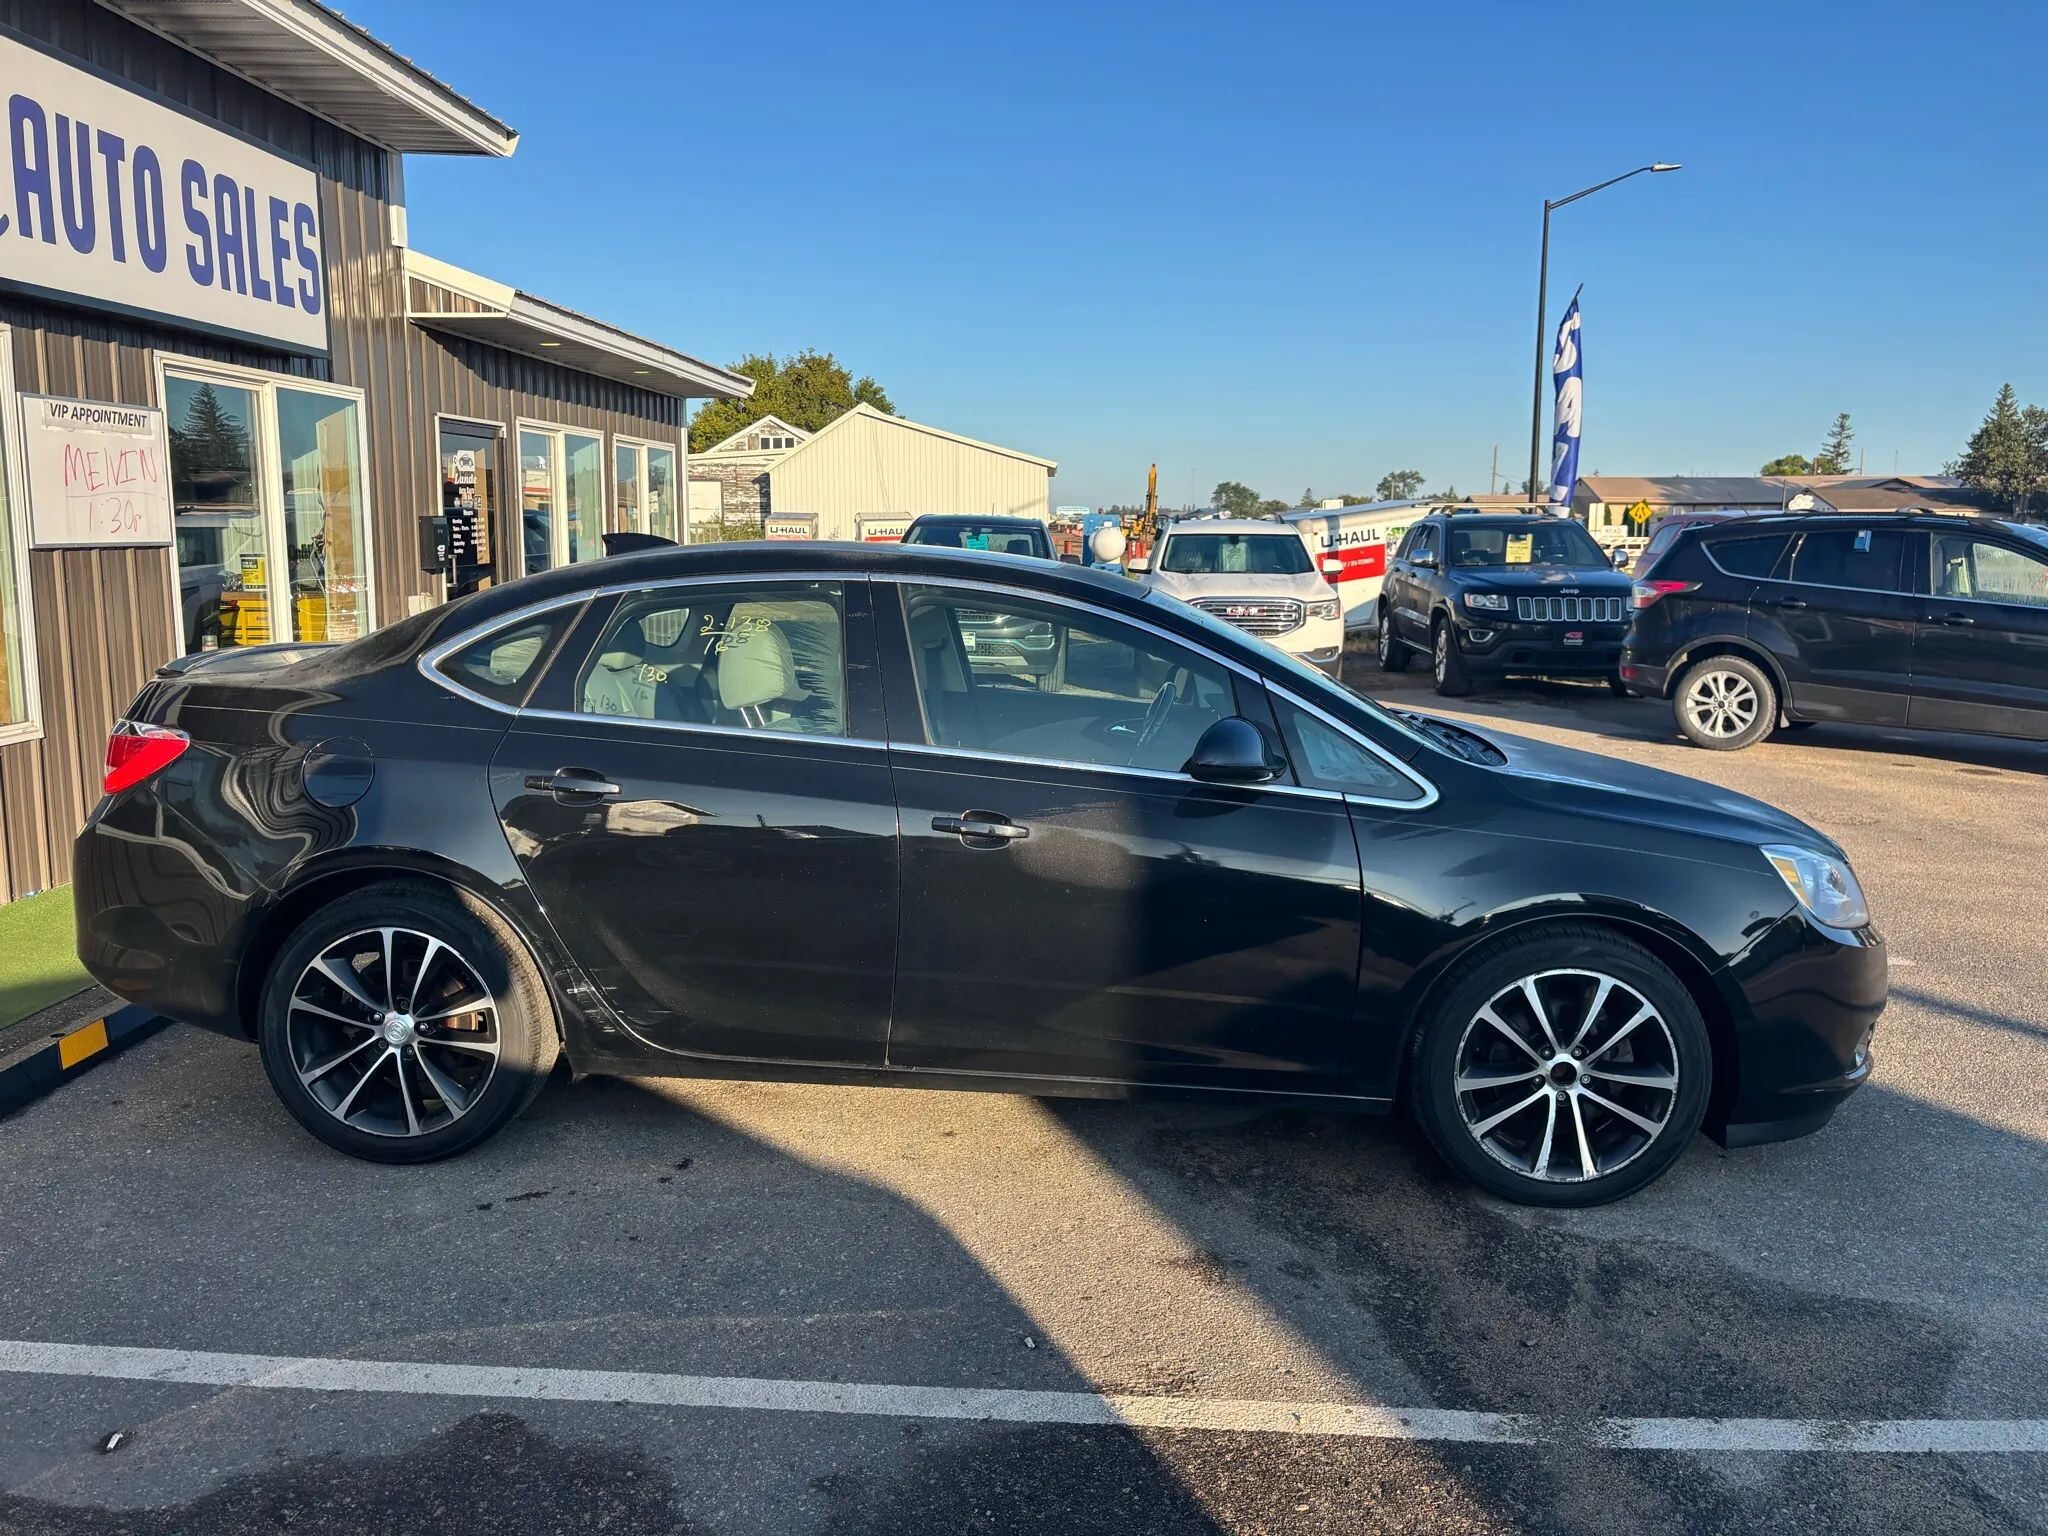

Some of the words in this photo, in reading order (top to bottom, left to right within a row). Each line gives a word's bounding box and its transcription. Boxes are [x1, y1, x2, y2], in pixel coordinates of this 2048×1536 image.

[9, 93, 168, 274] AUTO
[181, 158, 321, 315] SALES
[50, 403, 69, 418] VIP
[71, 406, 148, 428] APPOINTMENT
[454, 473, 478, 485] Lunde
[770, 526, 807, 534] U-HAUL
[1321, 529, 1380, 548] U-HAUL
